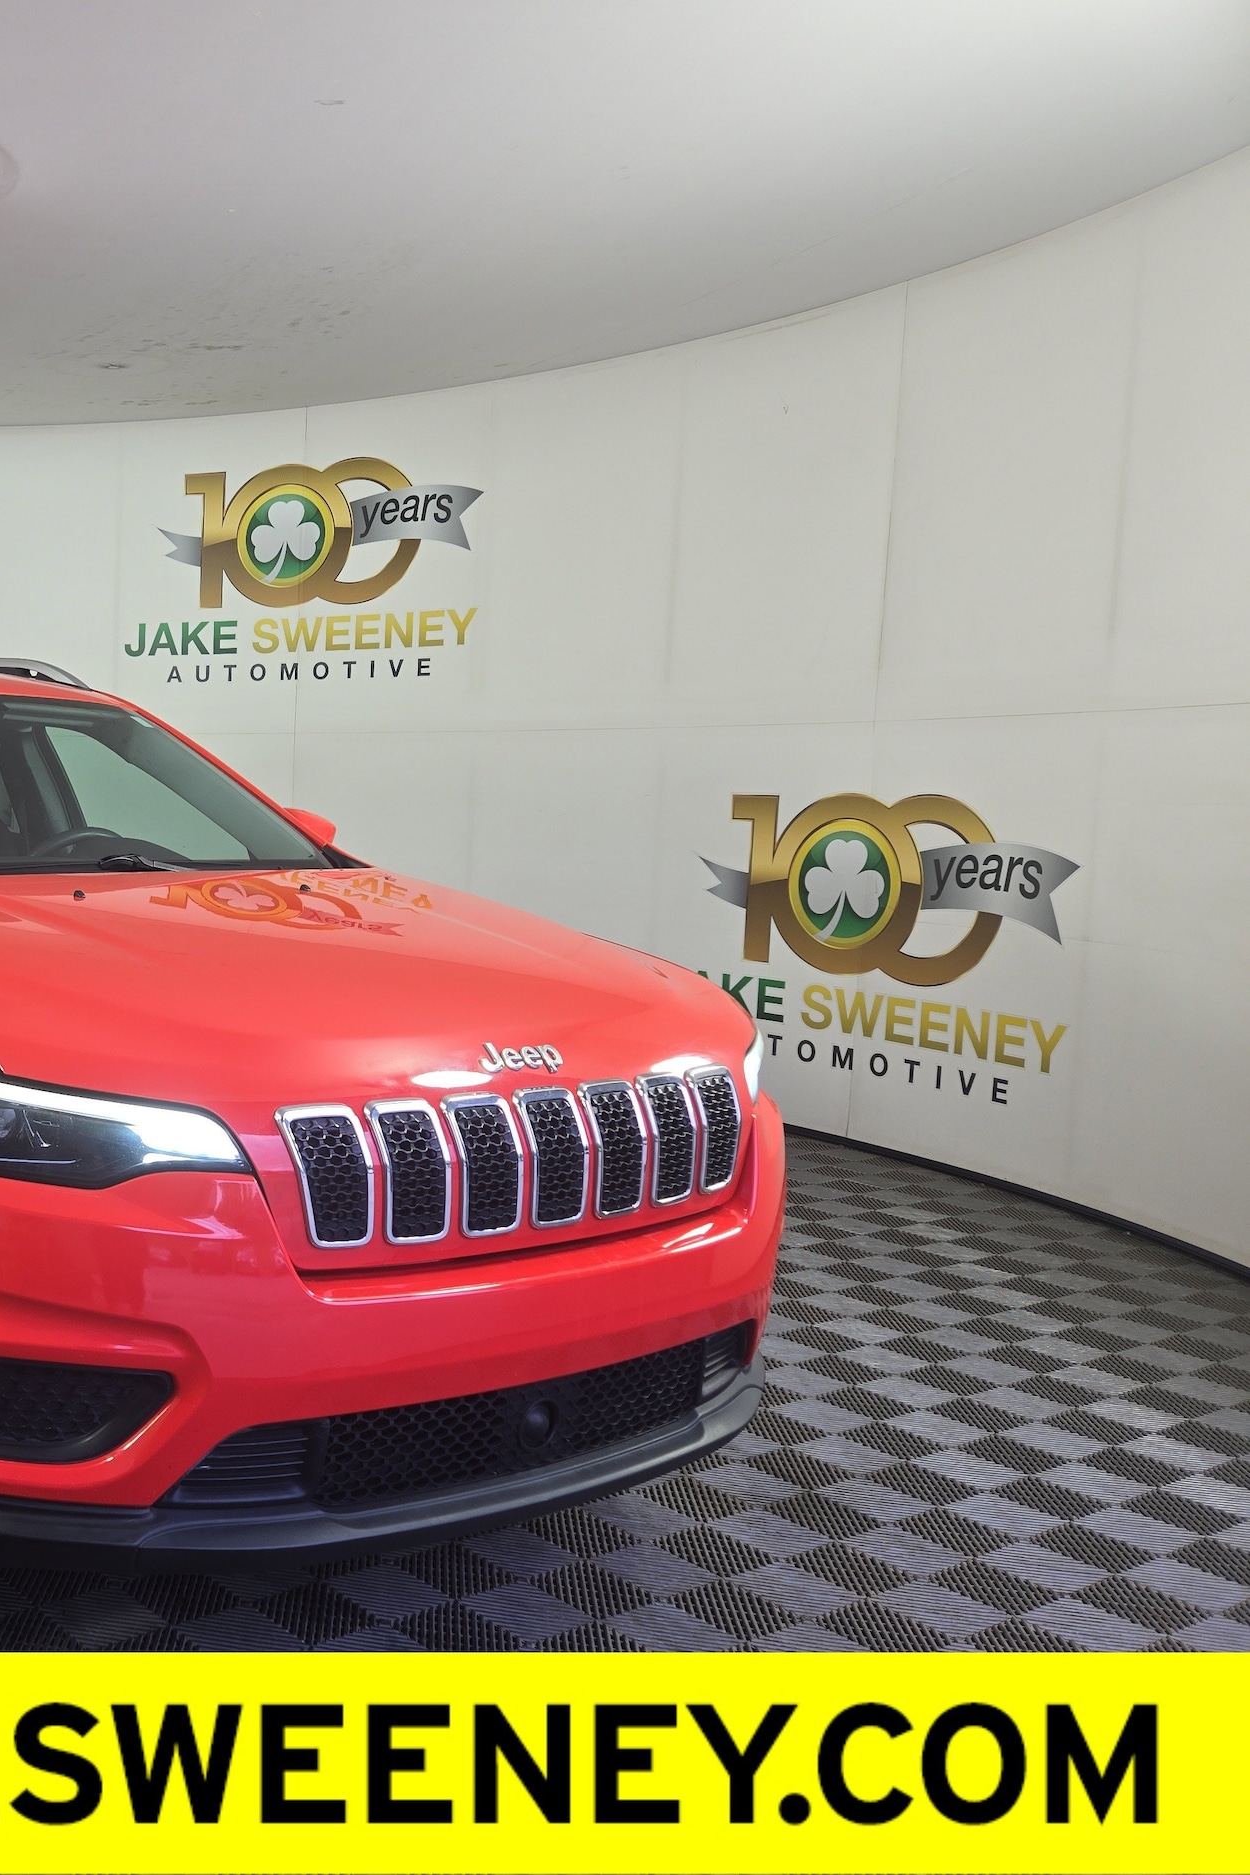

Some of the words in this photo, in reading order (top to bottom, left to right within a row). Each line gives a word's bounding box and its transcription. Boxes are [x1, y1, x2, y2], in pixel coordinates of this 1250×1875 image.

[359, 493, 453, 538] years
[124, 620, 238, 657] JAKE
[252, 607, 478, 654] SWEENEY
[166, 657, 431, 683] AUTOMOTIVE
[930, 854, 1044, 901] years
[697, 970, 786, 1023] KE
[800, 984, 1068, 1074] SWEENEY
[478, 1042, 564, 1074] Jeep
[768, 1034, 1010, 1105] TOMOTIVE
